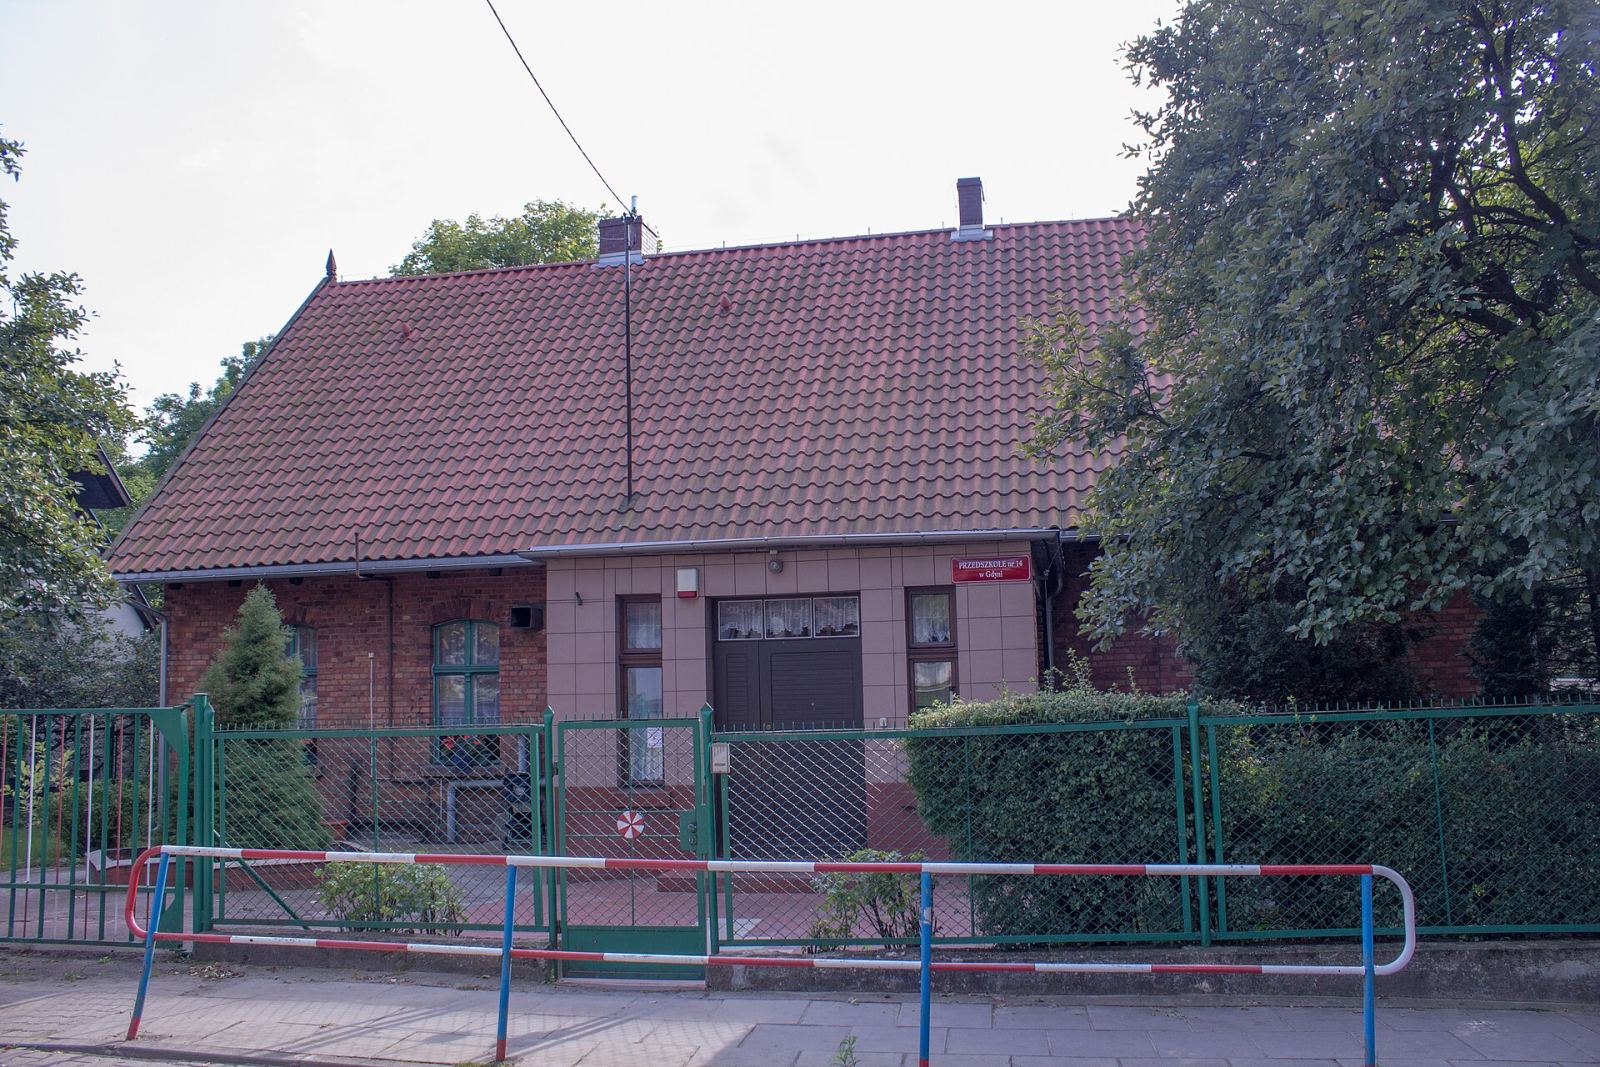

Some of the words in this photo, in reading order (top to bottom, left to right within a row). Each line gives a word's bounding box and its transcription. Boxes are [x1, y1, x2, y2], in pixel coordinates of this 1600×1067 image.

[958, 560, 1006, 569] PRZEDSZKOLE
[1016, 560, 1023, 568] 14
[985, 570, 1003, 579] Gdyni
